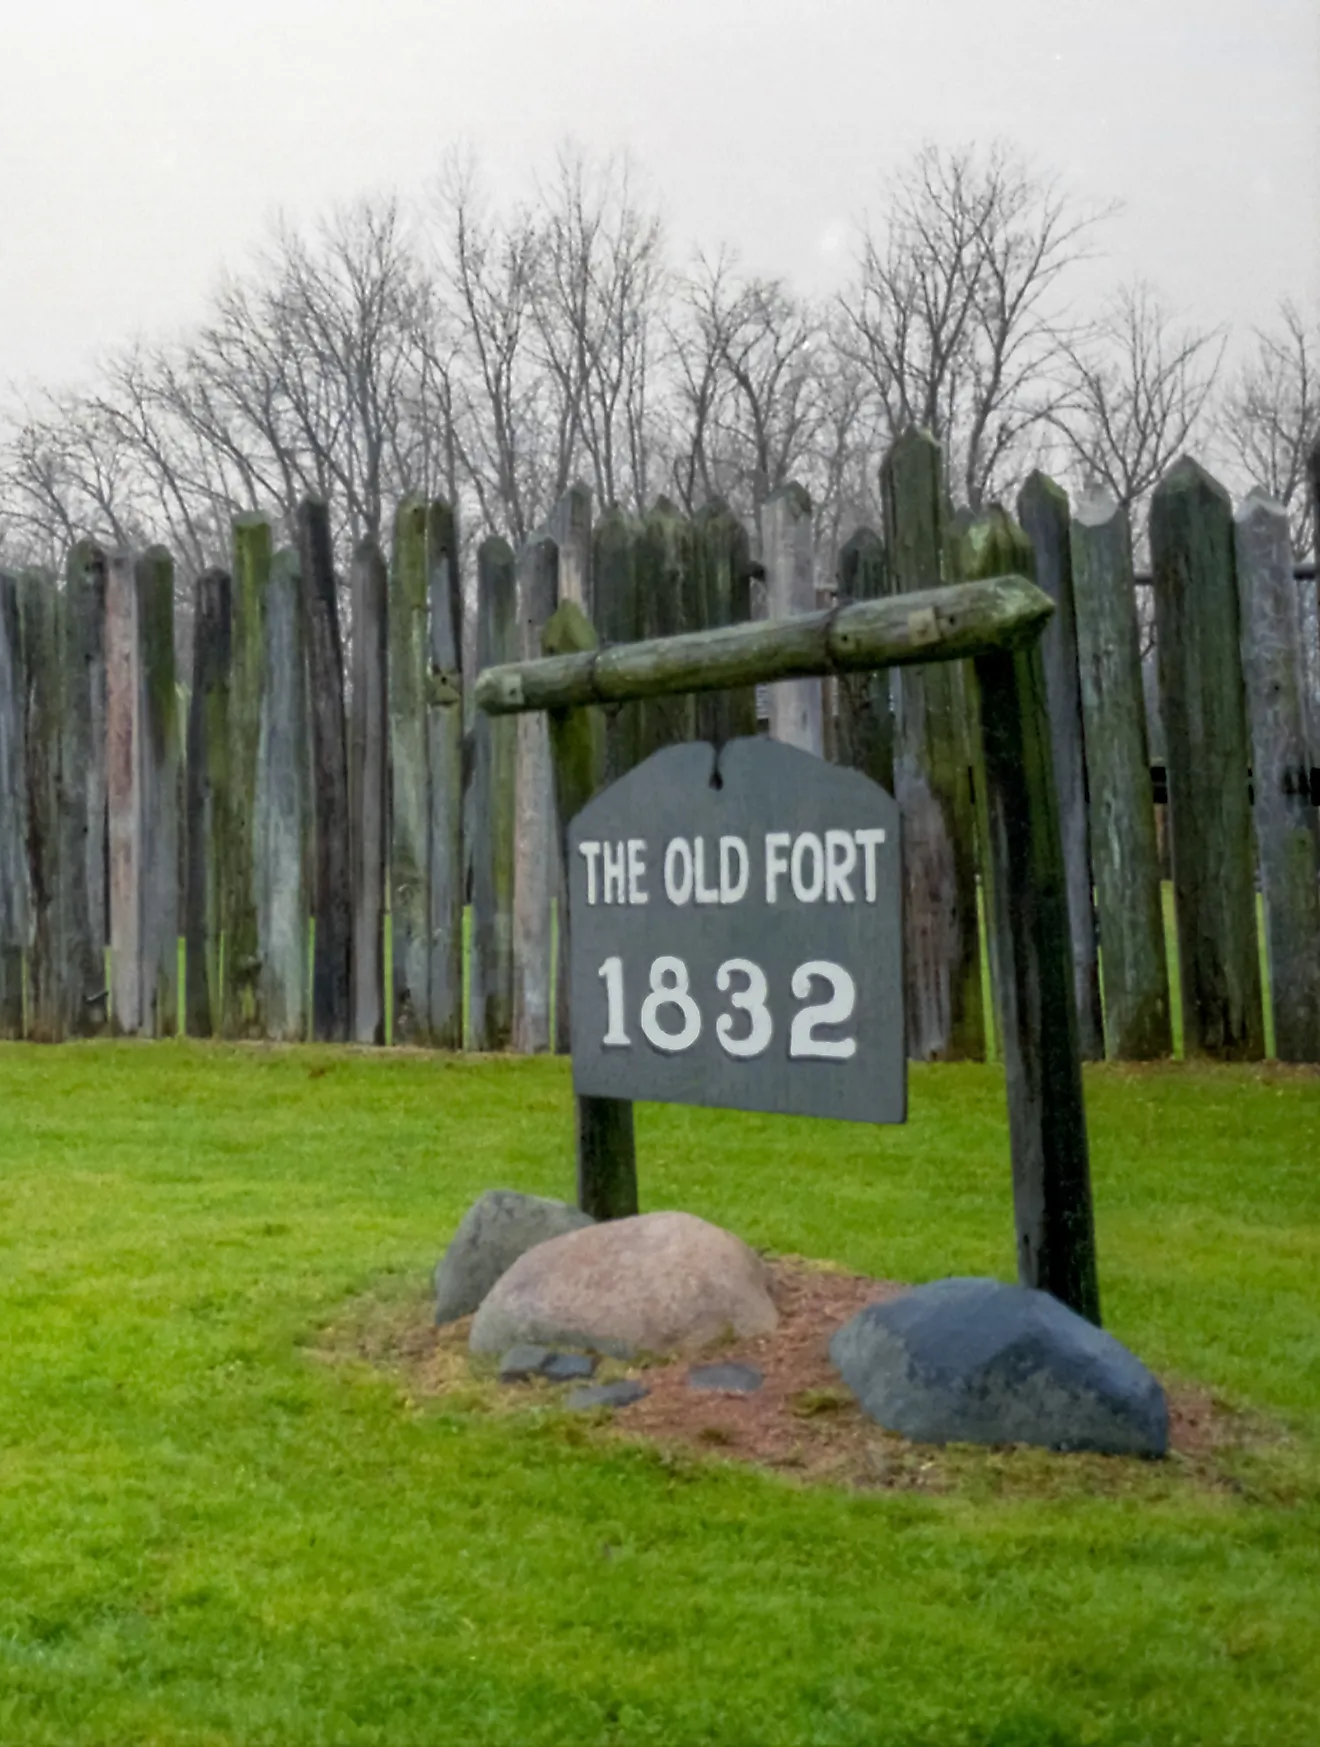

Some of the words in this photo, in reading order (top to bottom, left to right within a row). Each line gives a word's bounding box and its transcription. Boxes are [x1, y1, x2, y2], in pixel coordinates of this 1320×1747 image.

[579, 839, 648, 905] THE
[664, 835, 749, 906] OLD
[765, 828, 886, 903] FORT
[598, 955, 856, 1058] 1832
